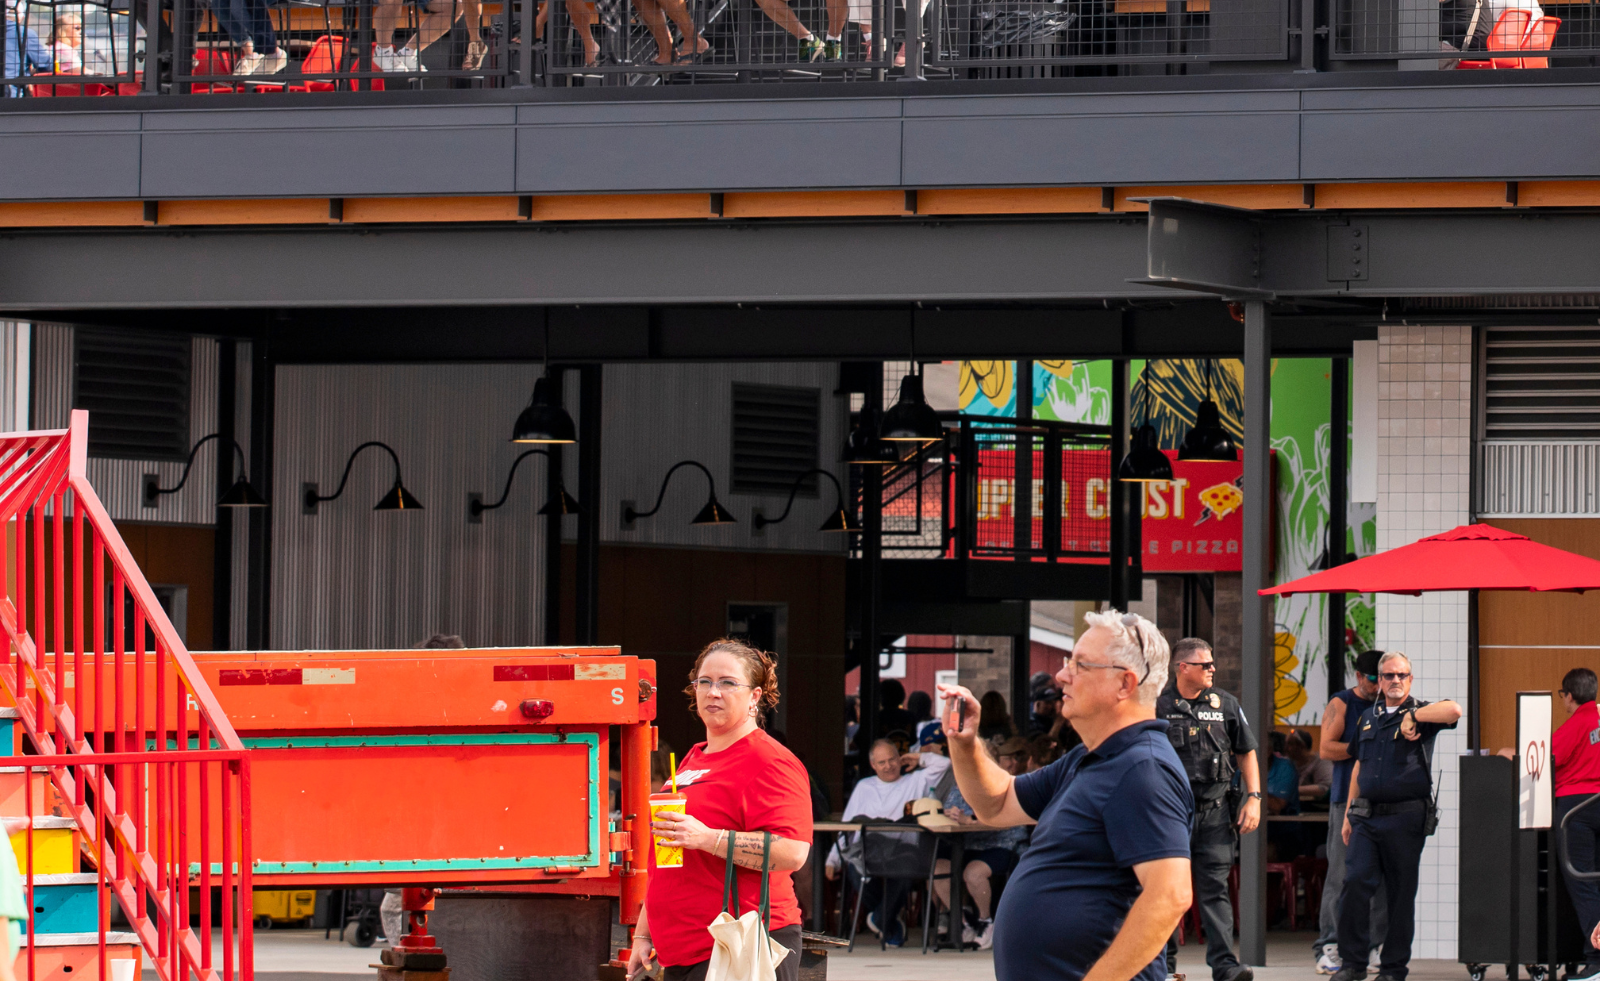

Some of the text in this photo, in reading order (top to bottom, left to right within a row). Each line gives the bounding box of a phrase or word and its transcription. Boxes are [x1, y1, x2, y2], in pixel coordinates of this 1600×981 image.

[1172, 540, 1239, 553] PIZZA
[611, 687, 624, 705] S
[1198, 711, 1224, 722] POLICE
